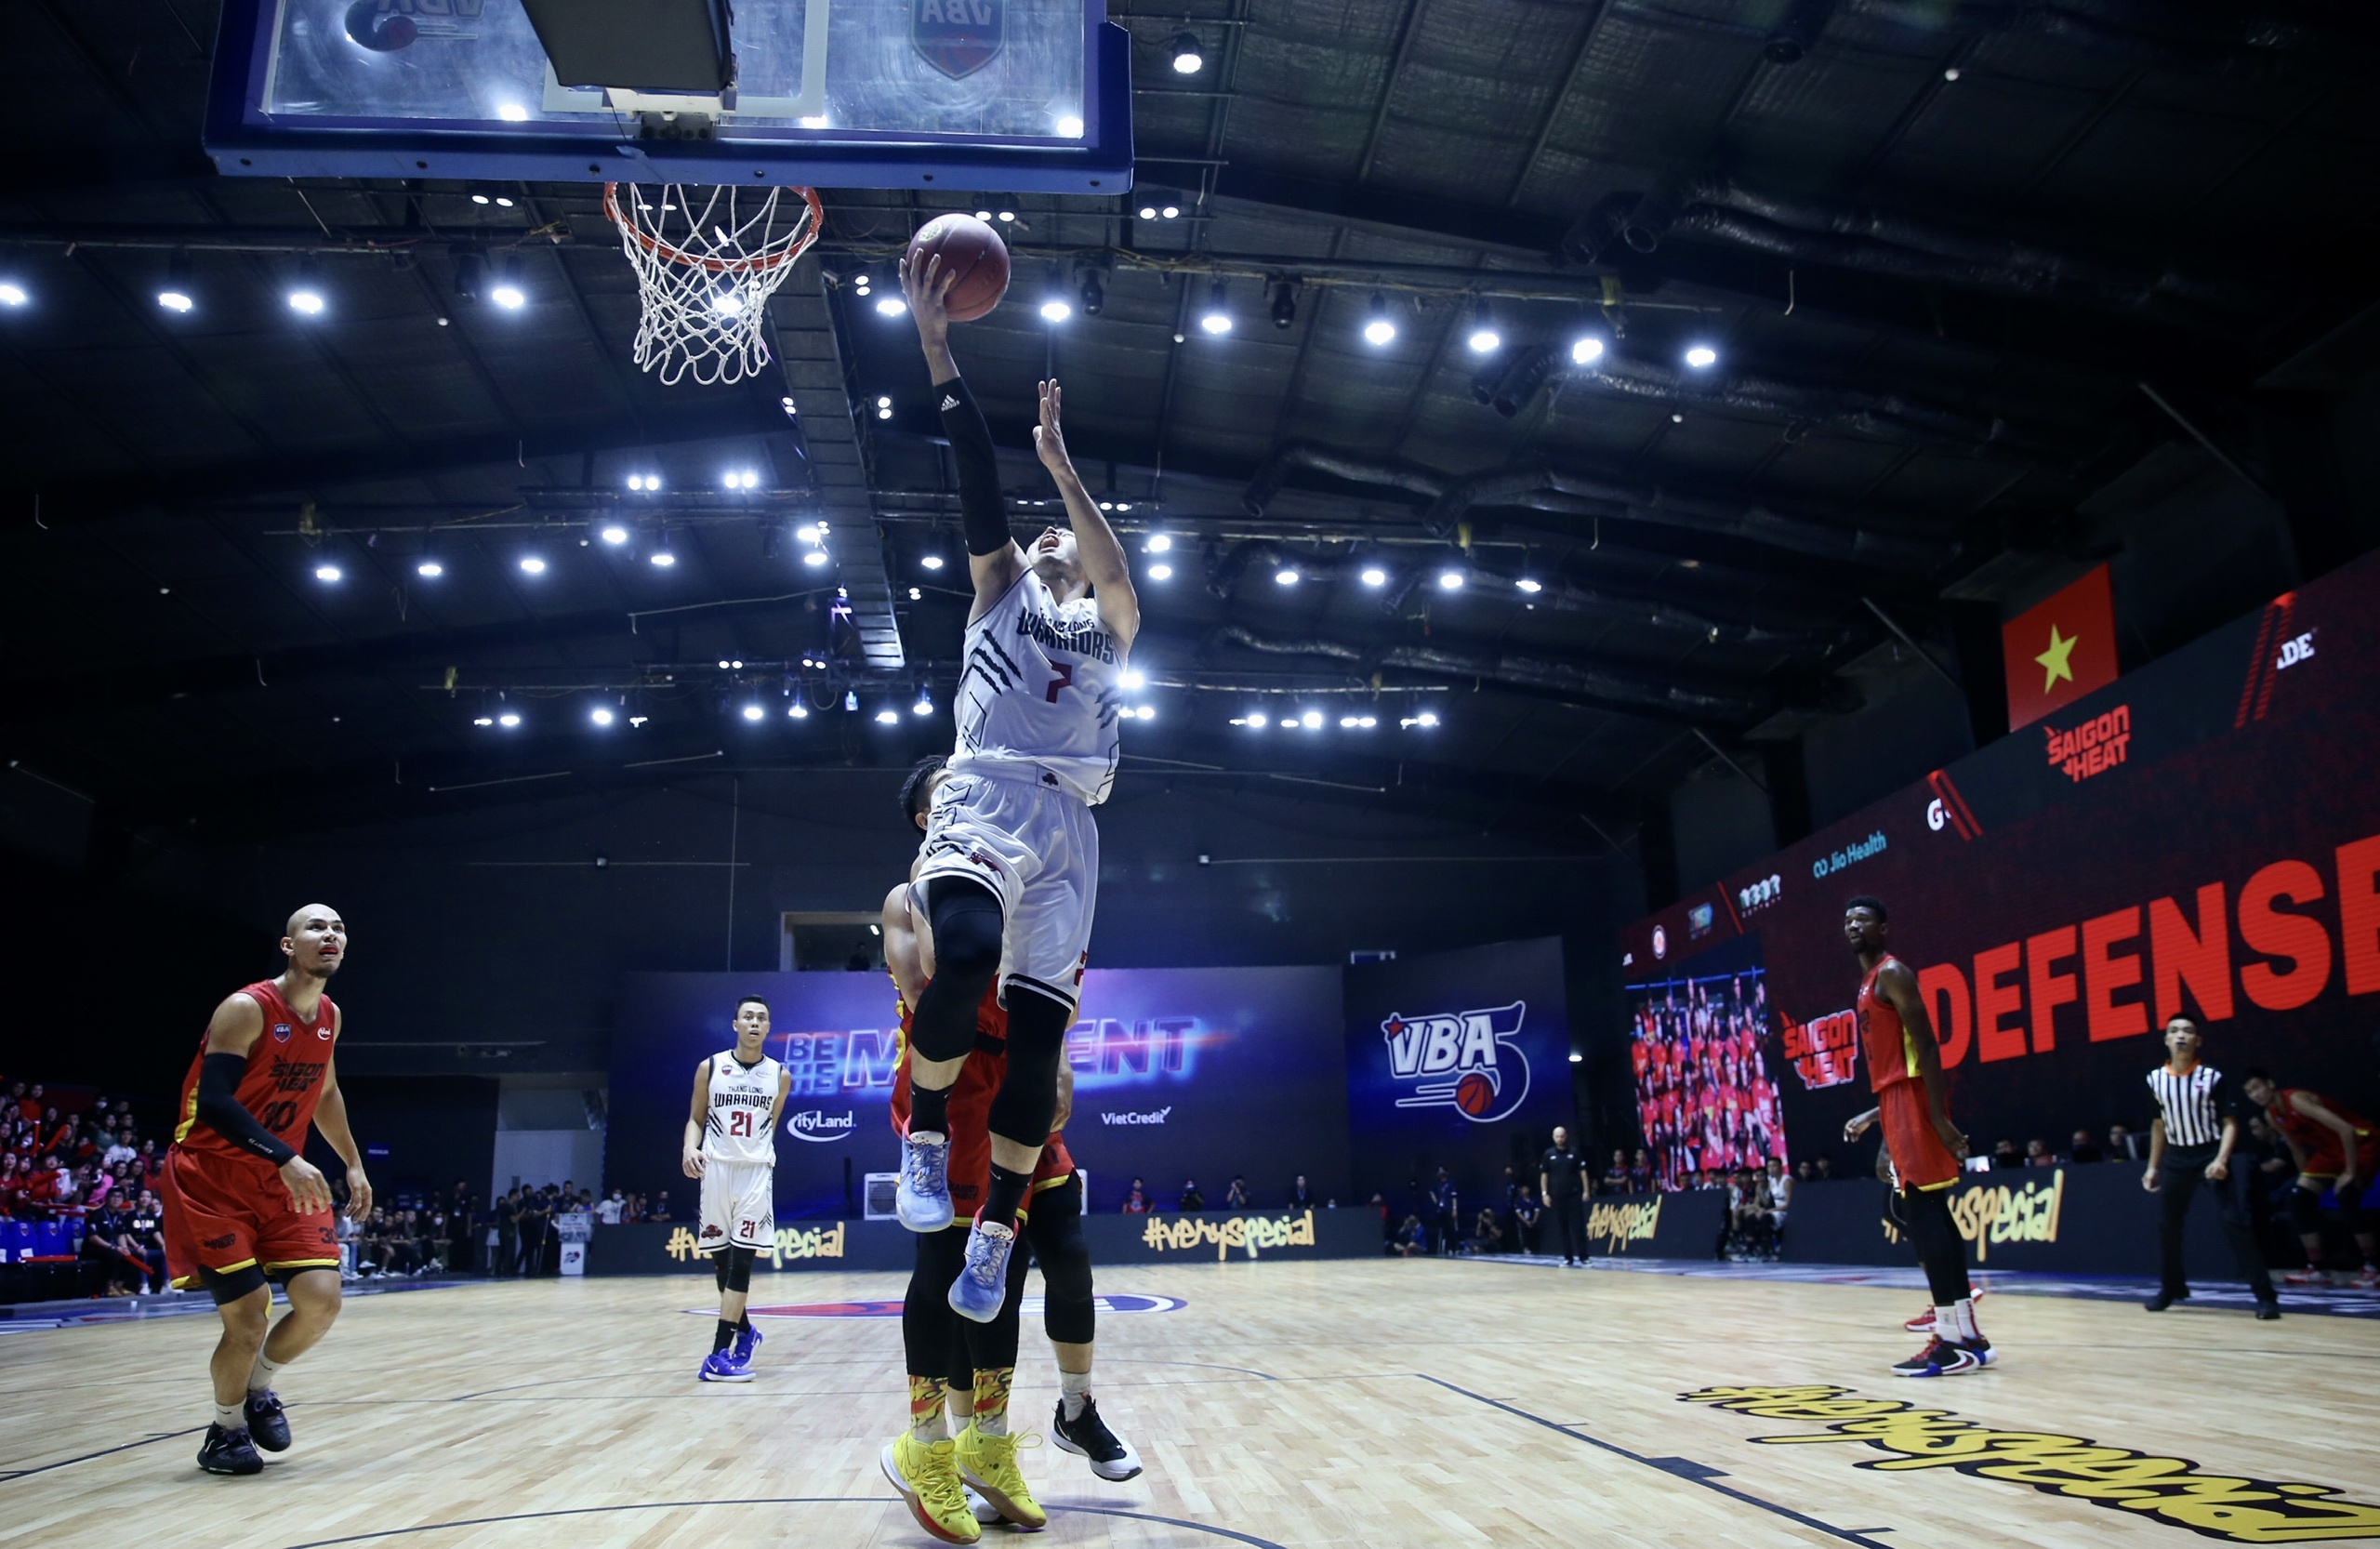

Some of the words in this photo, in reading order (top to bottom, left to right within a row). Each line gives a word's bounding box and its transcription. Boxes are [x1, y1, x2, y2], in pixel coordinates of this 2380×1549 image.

[2277, 632, 2315, 669] DE
[1046, 659, 1073, 704] 7
[2044, 704, 2131, 766] SAIGON
[2061, 733, 2131, 783] HEAT
[1830, 850, 1847, 872] Jio
[1846, 829, 1887, 865] Health
[786, 1032, 836, 1061] BE
[843, 1016, 1197, 1086] MENT
[1391, 1013, 1497, 1075] VBA
[1781, 1010, 1858, 1059] SAIGON
[1794, 1046, 1857, 1090] HEAT
[261, 1100, 298, 1132] 30
[714, 1092, 773, 1111] WARRIORS
[1101, 1108, 1168, 1126] VietCredit
[730, 1110, 752, 1138] 21
[319, 1226, 338, 1245] 30
[740, 1220, 756, 1238] 21
[1143, 1209, 1315, 1262] #veryspecial
